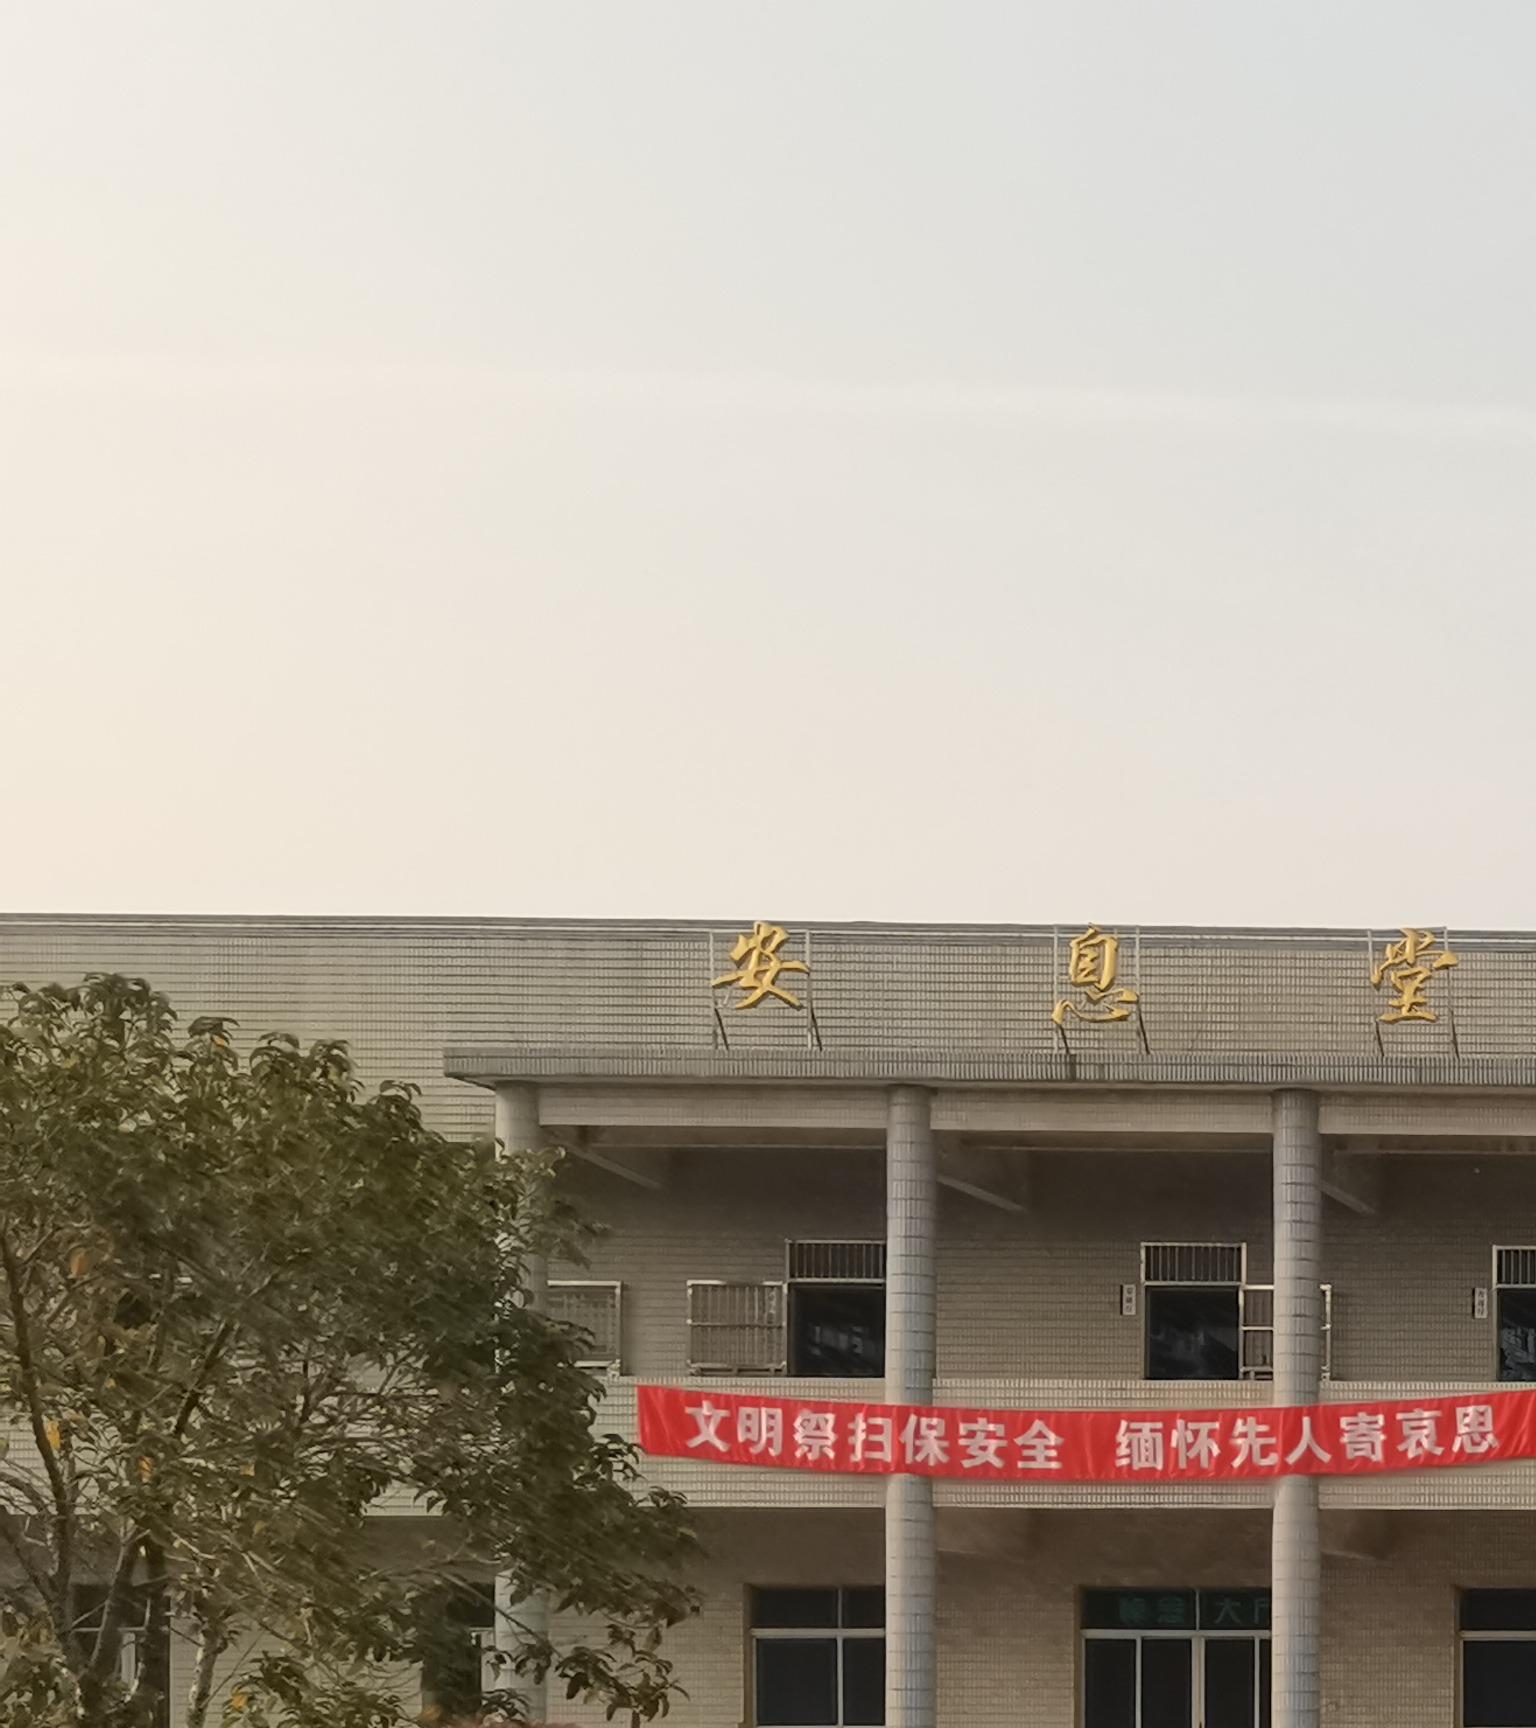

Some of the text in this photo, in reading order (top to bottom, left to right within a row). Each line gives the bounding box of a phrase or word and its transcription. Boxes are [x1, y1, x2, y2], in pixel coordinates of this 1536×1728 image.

[711, 920, 1459, 1026] 安息堂
[683, 1401, 1500, 1471] 文明祭扫保安全 缅怀先人寄哀思
